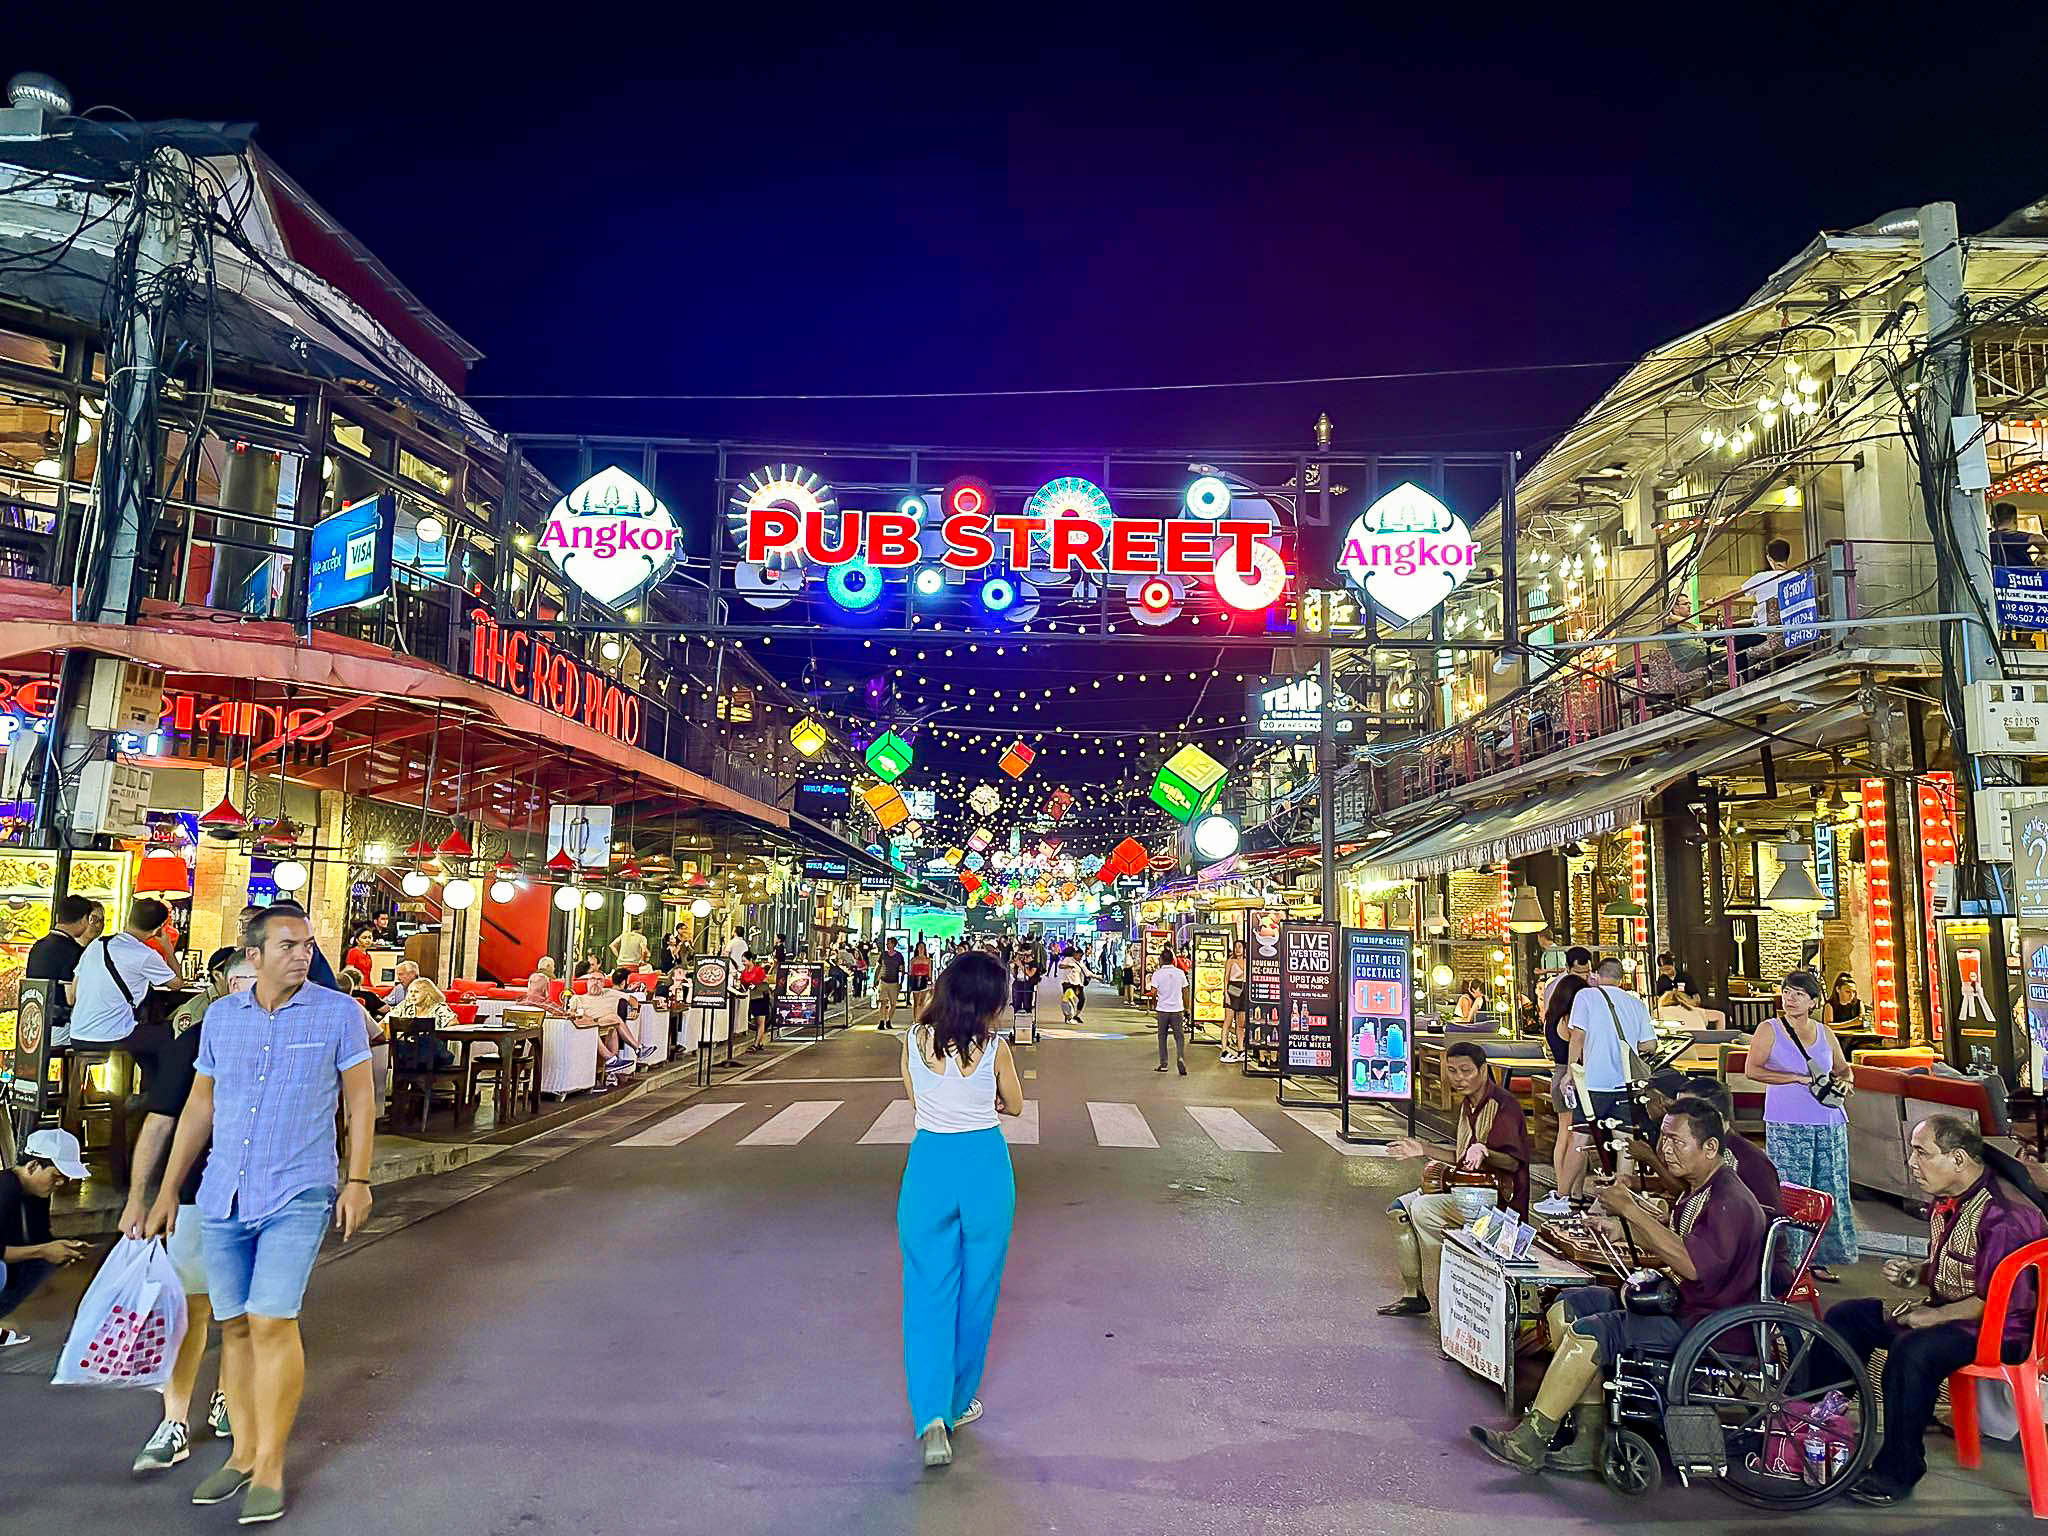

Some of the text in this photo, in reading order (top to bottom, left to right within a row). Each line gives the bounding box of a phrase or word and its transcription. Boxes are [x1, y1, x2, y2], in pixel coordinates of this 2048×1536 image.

[539, 519, 679, 559] Angkor
[747, 510, 1273, 575] PUB STREET
[351, 541, 372, 564] VISA
[1339, 537, 1479, 576] Angkor
[2018, 604, 2034, 613] 493
[2018, 613, 2033, 623] 507
[471, 607, 639, 746] THE RED PIANO
[1289, 933, 1329, 950] LIVE
[1289, 949, 1329, 959] WESTERN
[1356, 953, 1401, 966] DRAFT BEER
[1289, 957, 1330, 971] BAND
[1356, 966, 1401, 979] COCKTAILS
[1289, 975, 1330, 985] UPSTAIRS
[1288, 1040, 1332, 1049] PLUS MIXER
